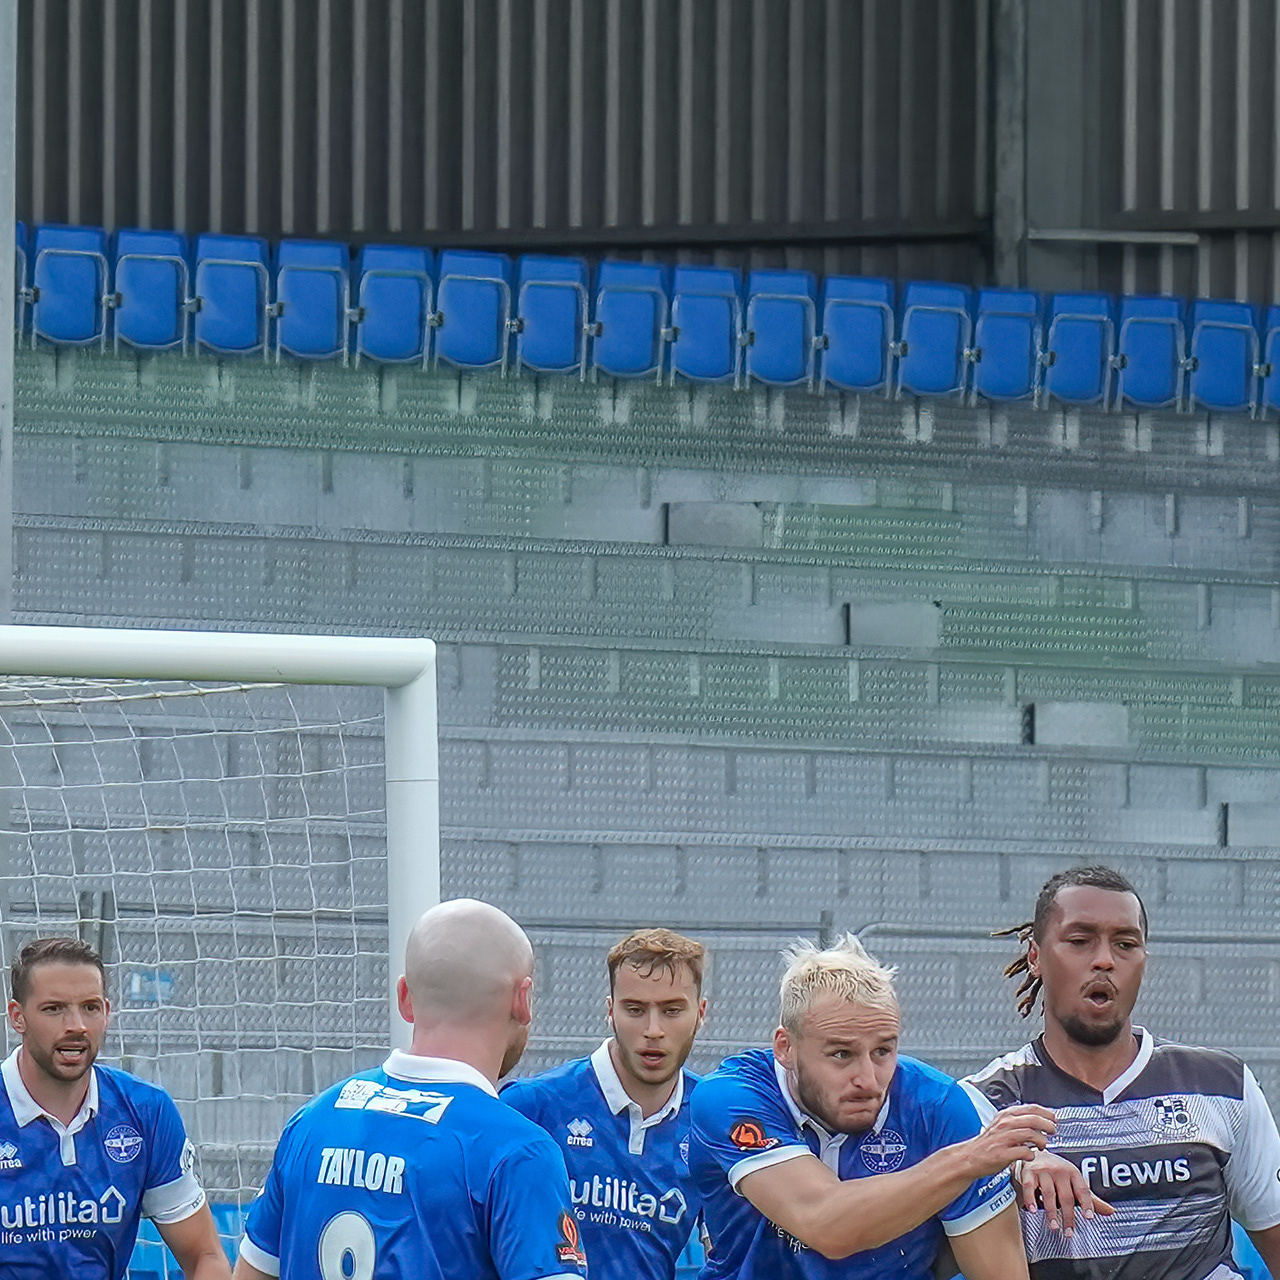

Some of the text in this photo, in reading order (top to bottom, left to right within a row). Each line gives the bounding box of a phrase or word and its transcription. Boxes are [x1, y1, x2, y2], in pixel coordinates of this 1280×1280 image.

[317, 1147, 405, 1194] TAYLOR
[1, 1191, 98, 1229] utilita
[570, 1174, 657, 1217] utilita
[1, 1231, 23, 1244] life
[26, 1227, 56, 1242] with
